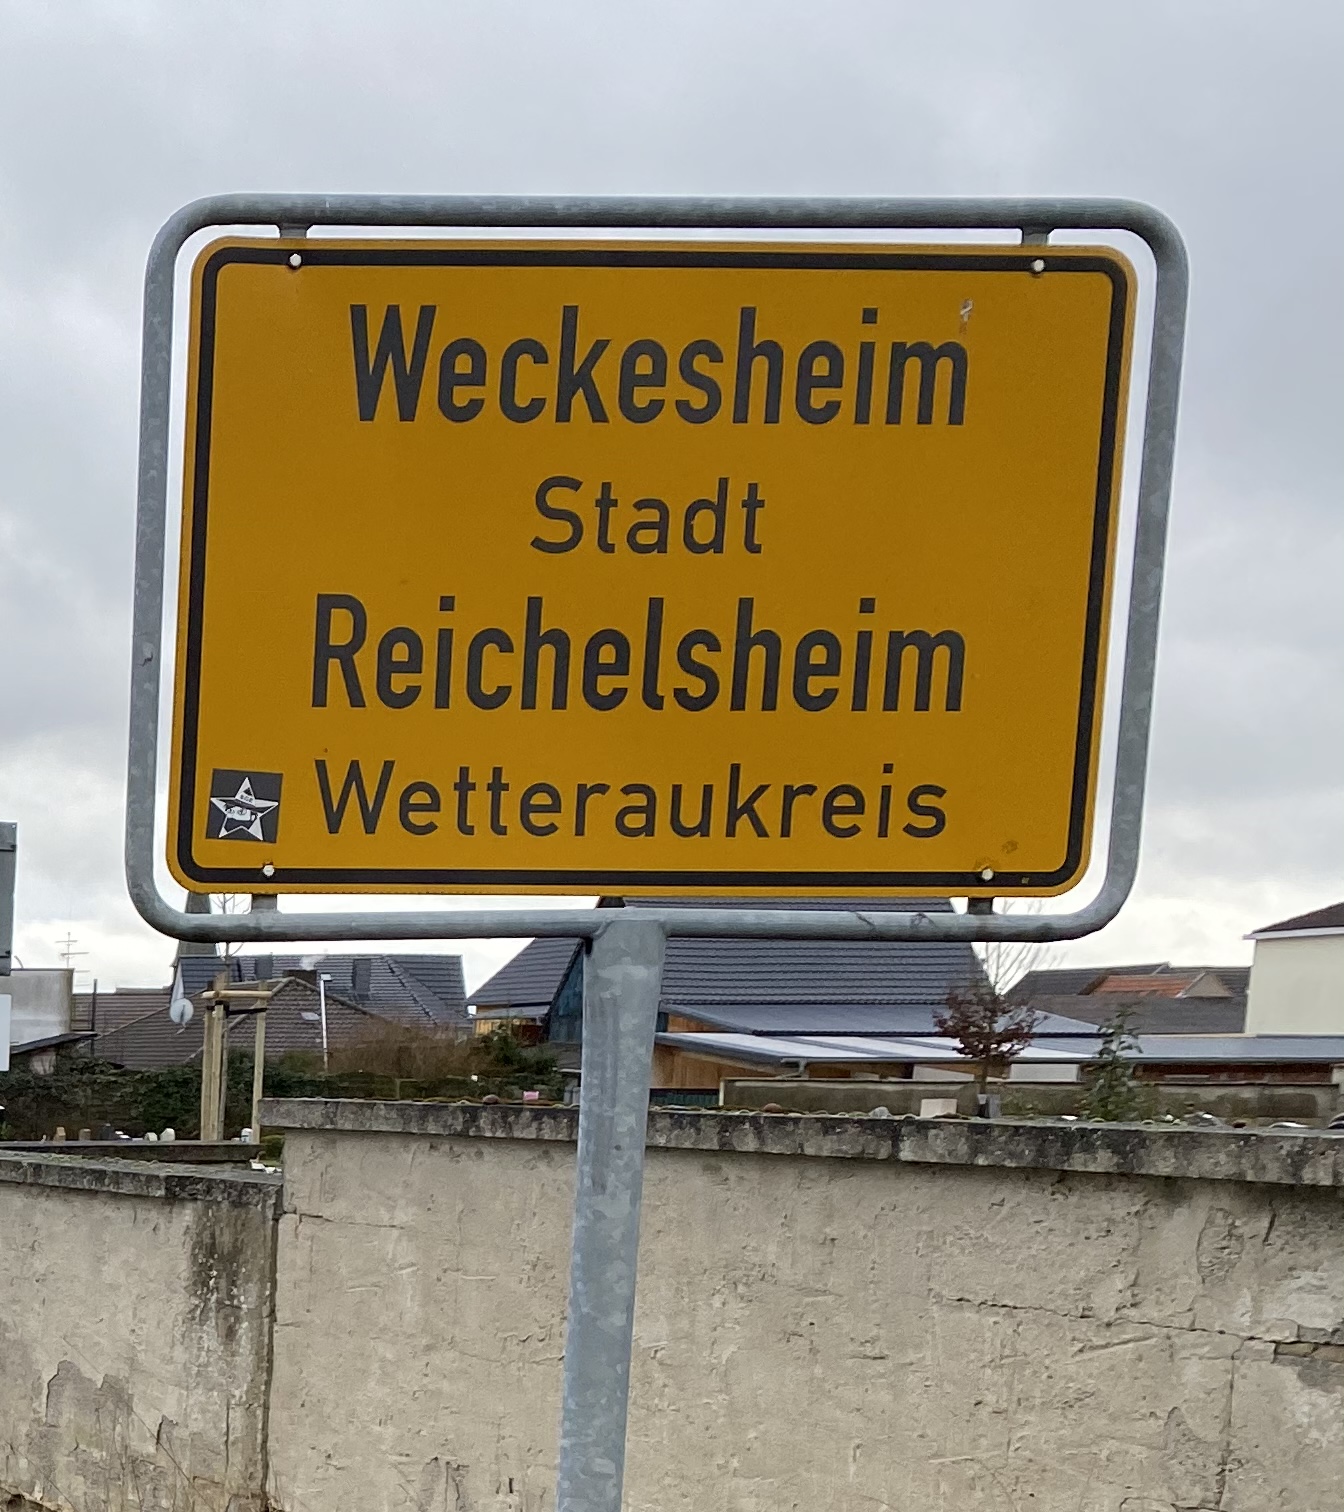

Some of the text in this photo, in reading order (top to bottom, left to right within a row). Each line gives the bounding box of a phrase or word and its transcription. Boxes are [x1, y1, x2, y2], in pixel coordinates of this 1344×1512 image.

[349, 303, 969, 426] Weckesheim
[529, 475, 766, 555] Stadt
[311, 593, 966, 713] Reichelsheim
[314, 759, 947, 839] Wetteraukreis
